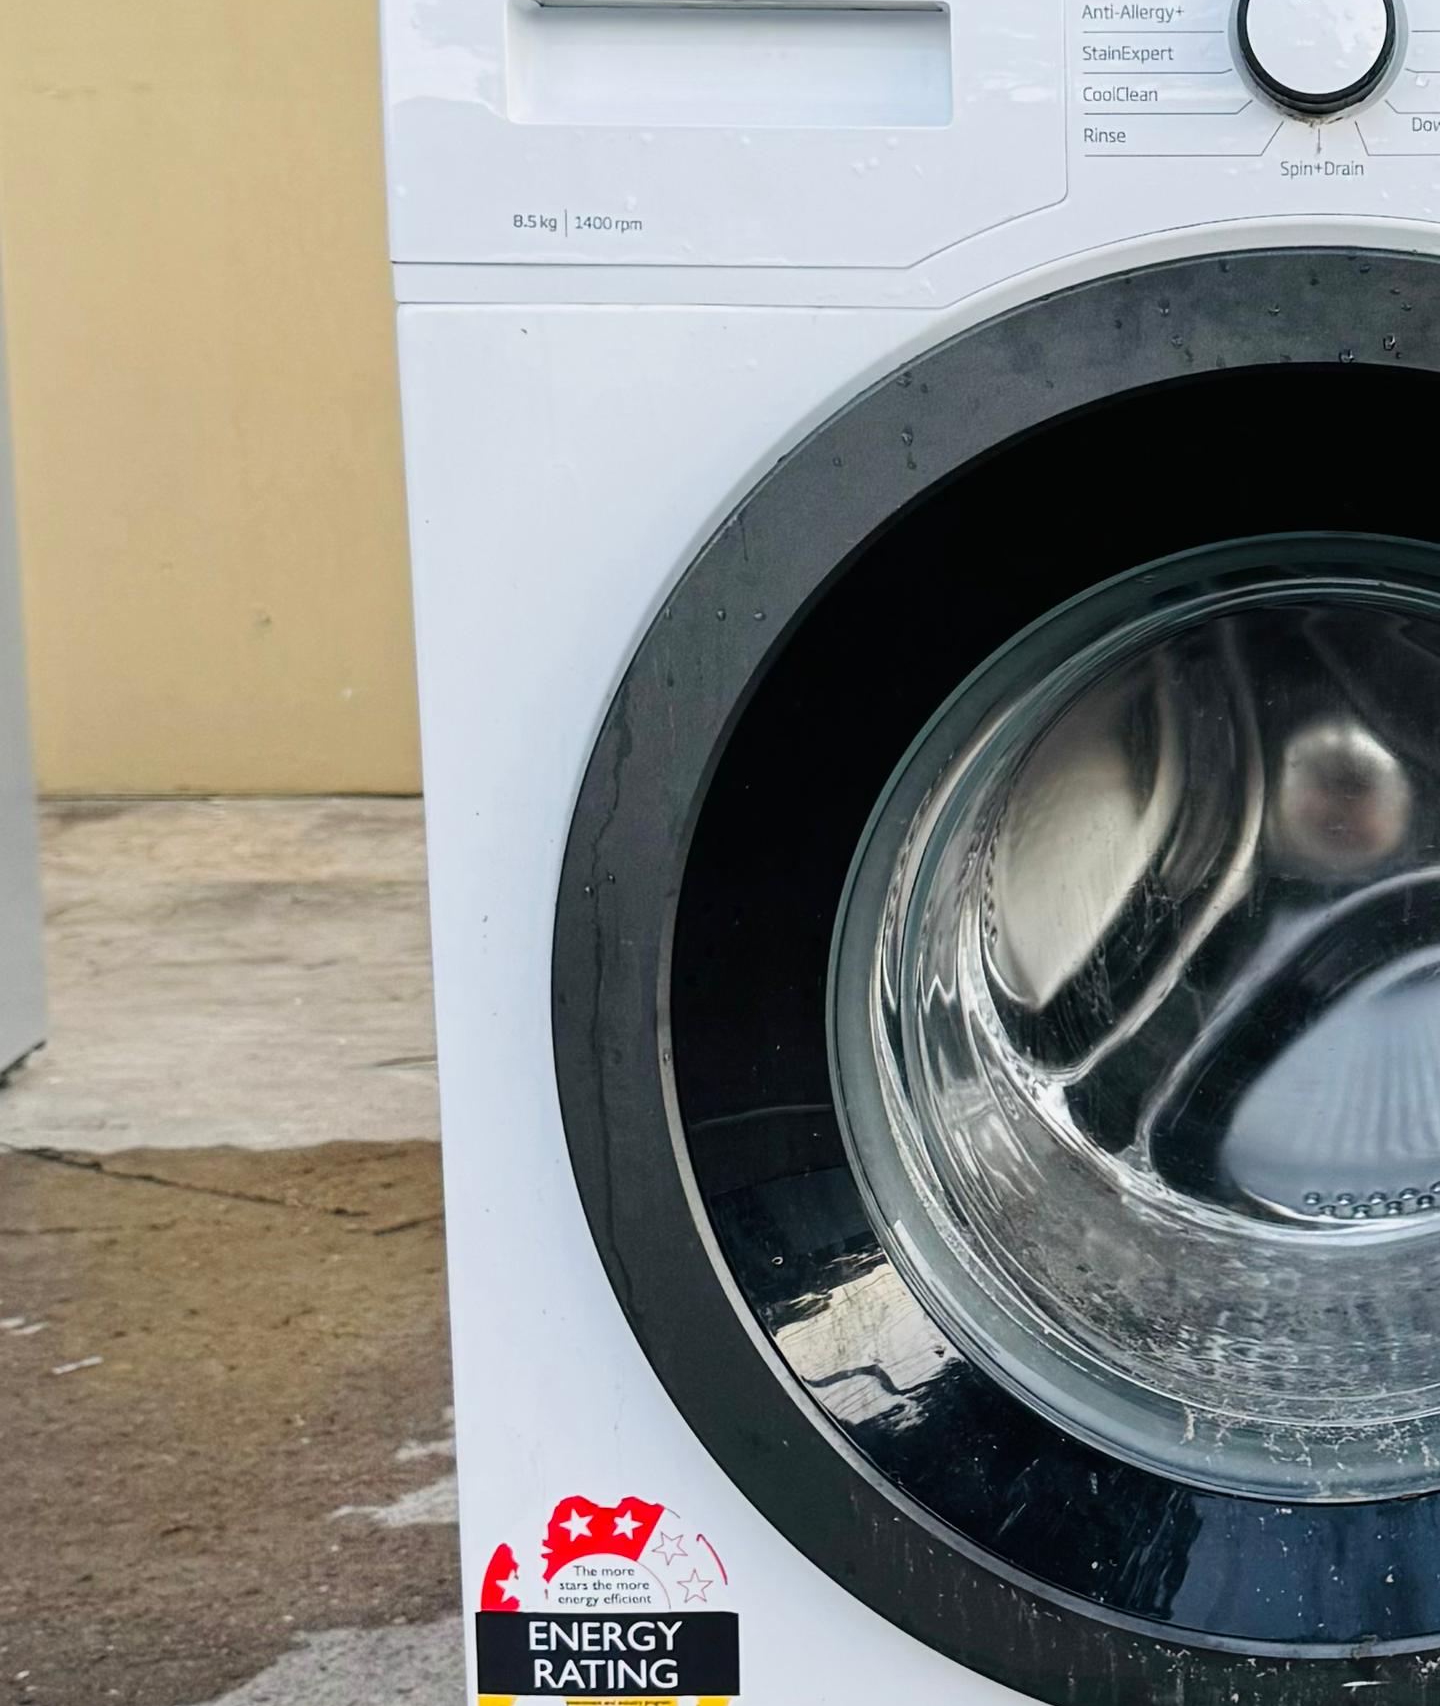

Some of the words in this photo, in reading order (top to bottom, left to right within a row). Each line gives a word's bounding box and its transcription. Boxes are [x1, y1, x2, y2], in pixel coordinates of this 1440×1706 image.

[1082, 4, 1185, 22] Anti-Allergy+
[1083, 45, 1173, 63] StainExpert
[1083, 86, 1158, 102] CoolClean
[1084, 128, 1126, 143] Rinse
[1281, 160, 1364, 178] Spin+Drain
[513, 214, 537, 228] 8.5
[540, 214, 557, 232] kg
[575, 216, 612, 230] 1400
[615, 219, 642, 233] rpm
[573, 1565, 597, 1576] The
[601, 1568, 634, 1576] more
[560, 1582, 587, 1590] stars
[593, 1579, 612, 1590] the
[617, 1582, 649, 1590] more
[558, 1596, 599, 1607] energy
[604, 1593, 651, 1604] efficient
[529, 1621, 682, 1651] ENERGY
[534, 1659, 679, 1689] RATING
